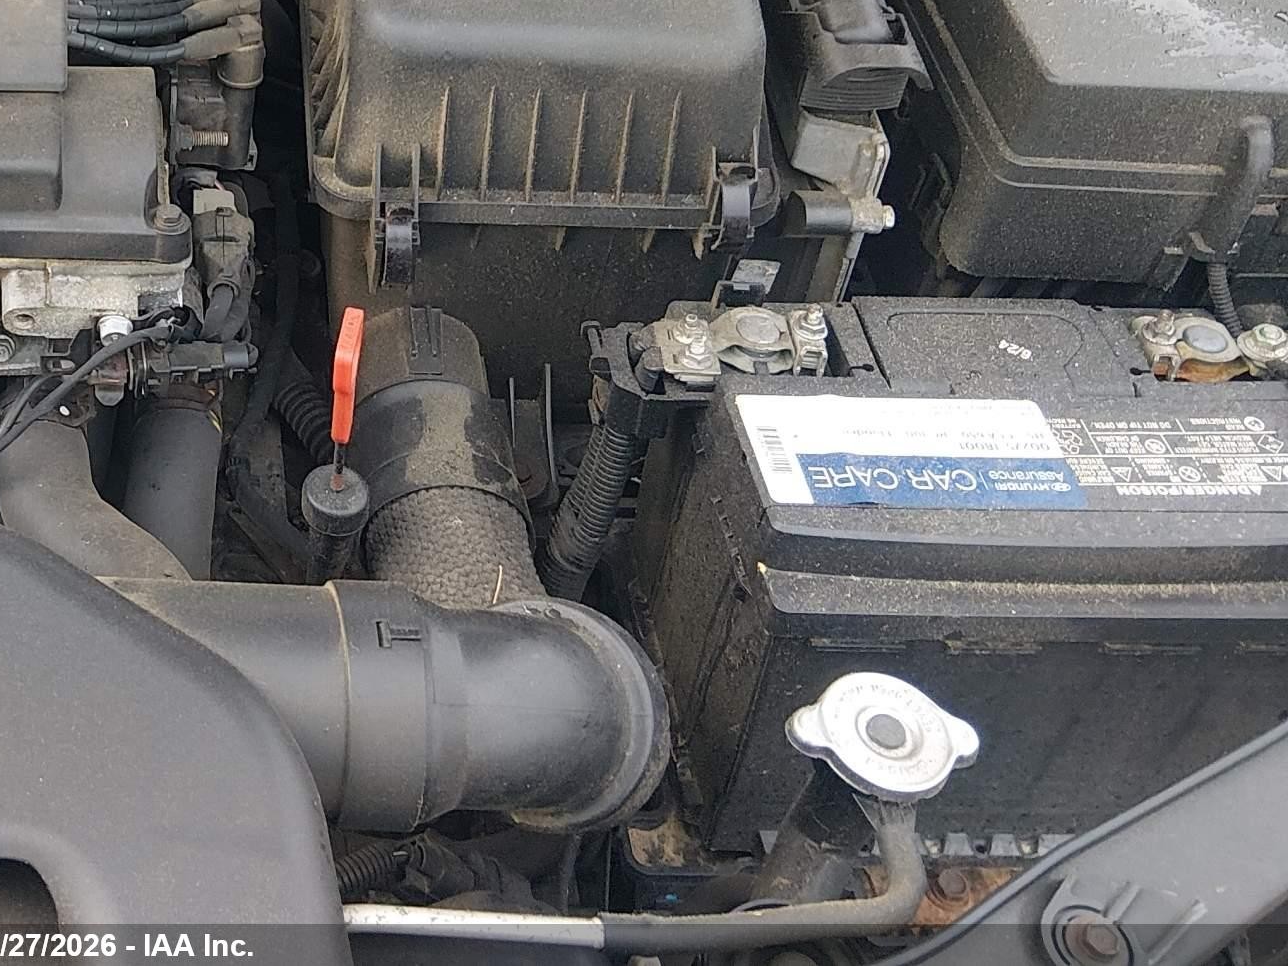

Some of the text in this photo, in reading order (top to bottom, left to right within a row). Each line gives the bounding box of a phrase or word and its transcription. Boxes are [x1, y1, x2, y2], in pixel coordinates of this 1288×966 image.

[807, 465, 977, 490] CAR CARE
[988, 470, 1064, 482] Assurance
[1115, 485, 1251, 496] DANGER/POISON
